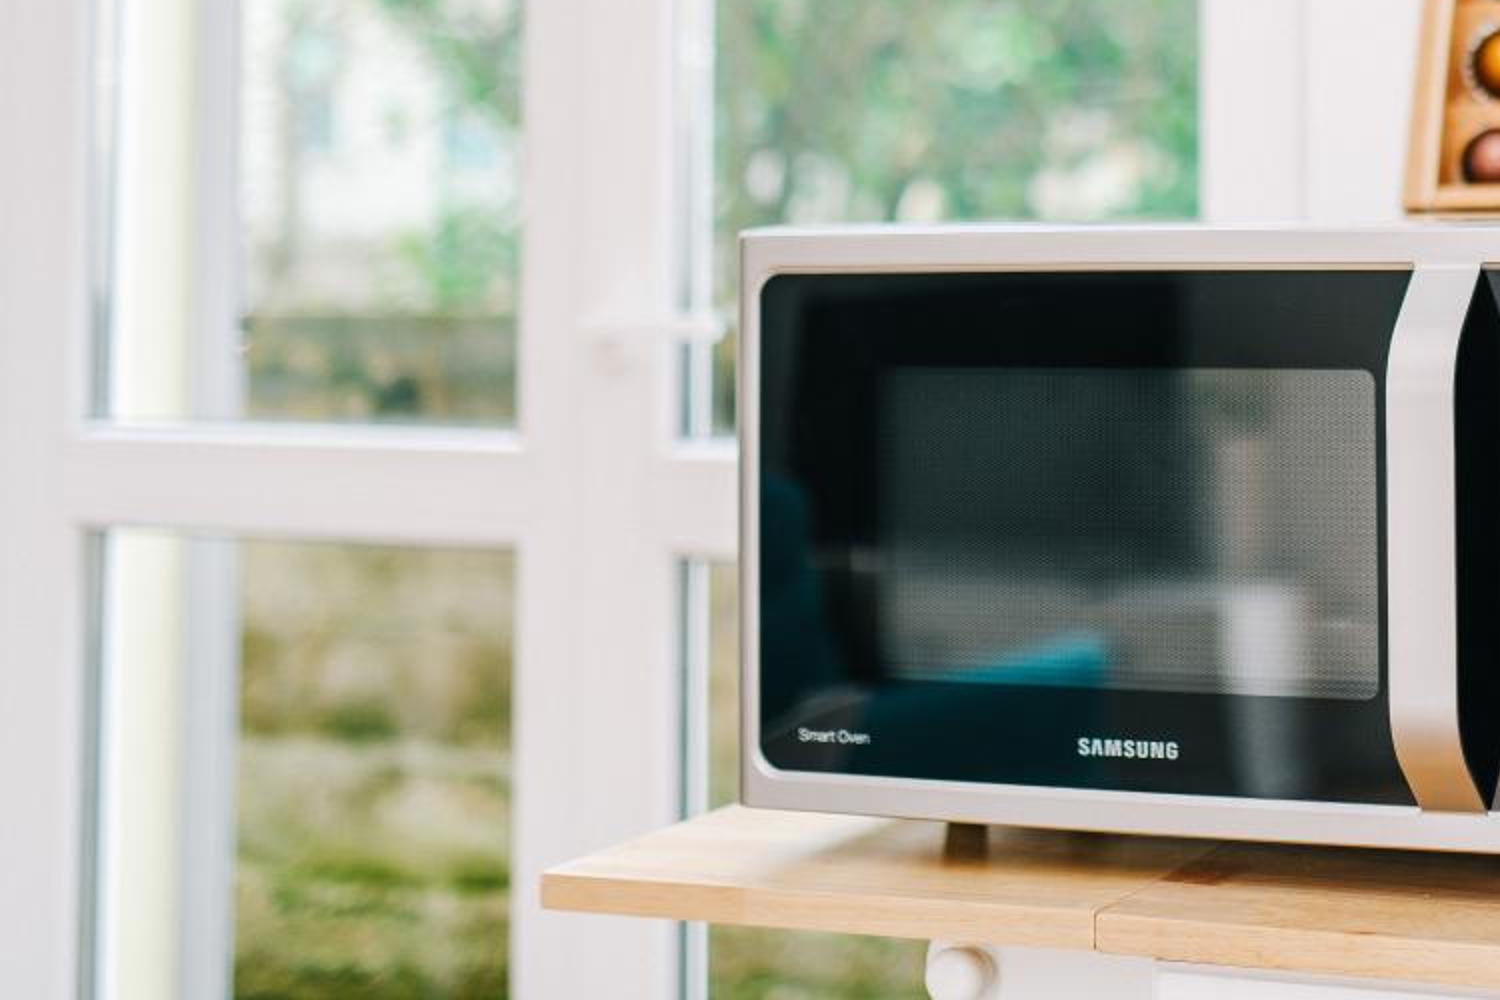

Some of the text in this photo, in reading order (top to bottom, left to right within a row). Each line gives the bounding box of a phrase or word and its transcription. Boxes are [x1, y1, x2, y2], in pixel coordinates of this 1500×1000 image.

[797, 727, 871, 745] Smart Oven
[1077, 737, 1179, 760] SAMSUNG
